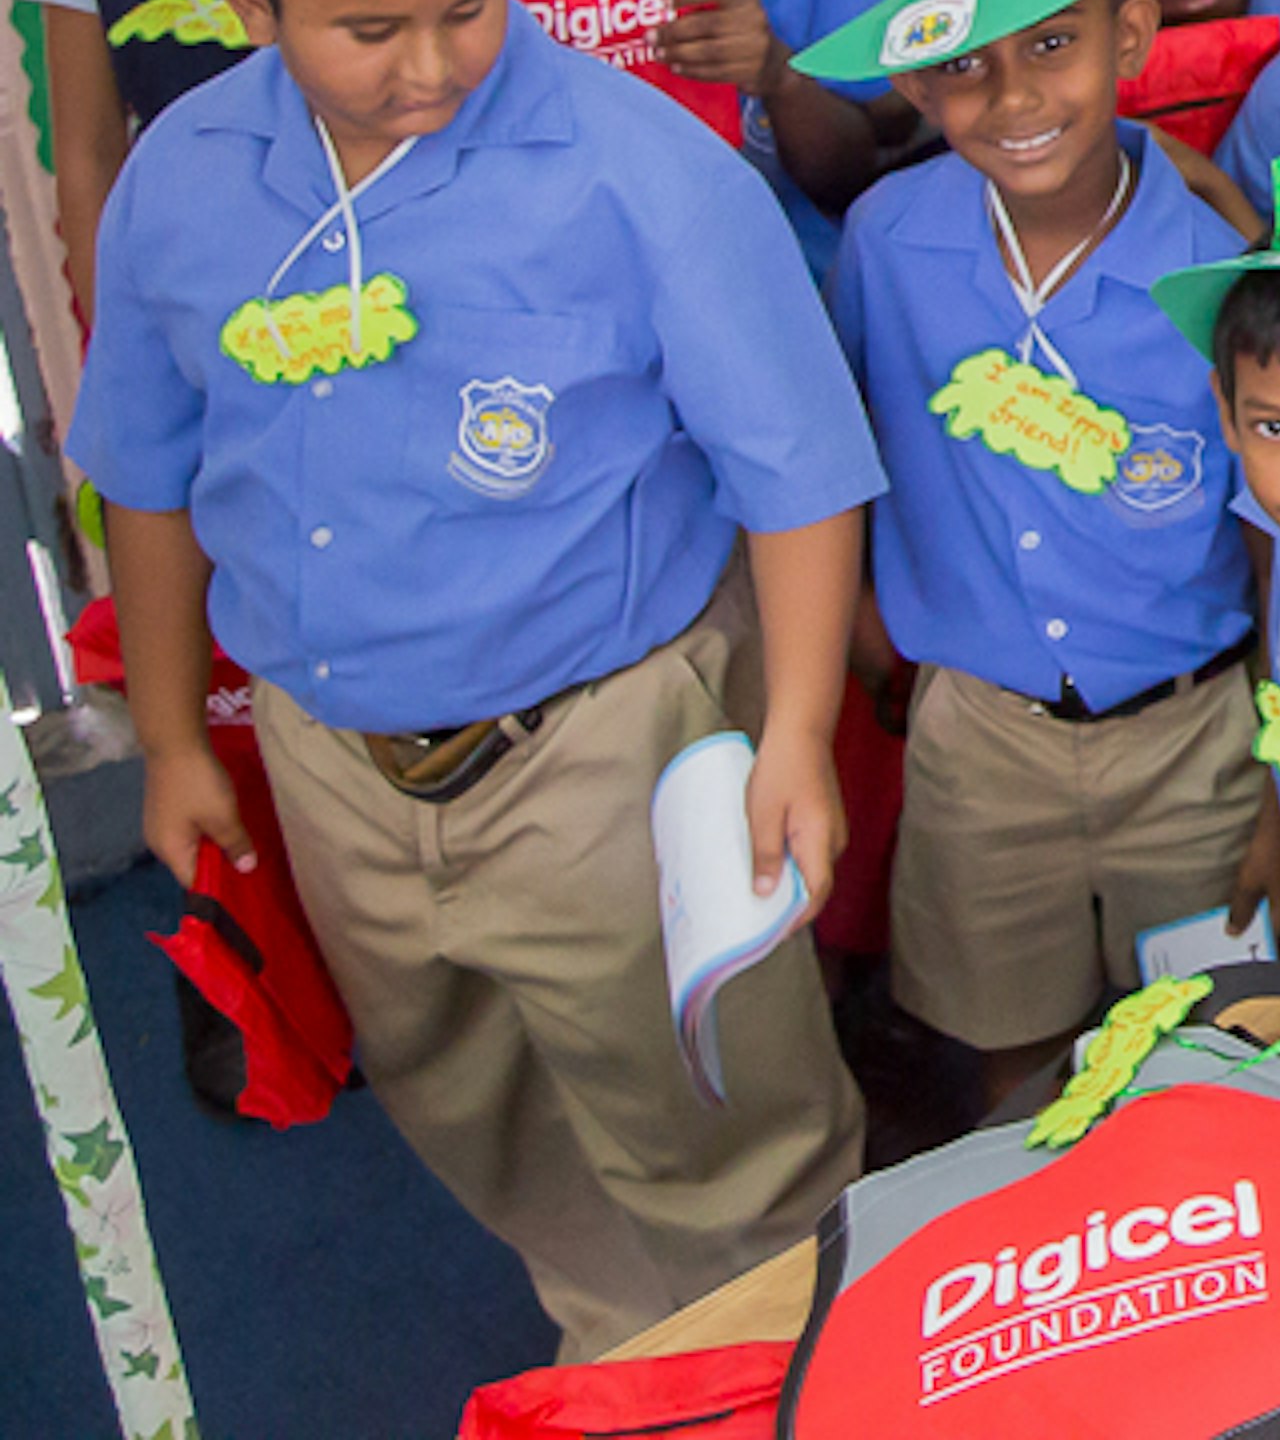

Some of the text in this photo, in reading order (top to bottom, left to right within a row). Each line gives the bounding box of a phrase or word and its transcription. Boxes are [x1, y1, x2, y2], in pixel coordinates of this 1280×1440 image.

[1016, 381, 1053, 404] am
[920, 1178, 1262, 1339] Digicel
[921, 1262, 1268, 1392] FOUNDATION
